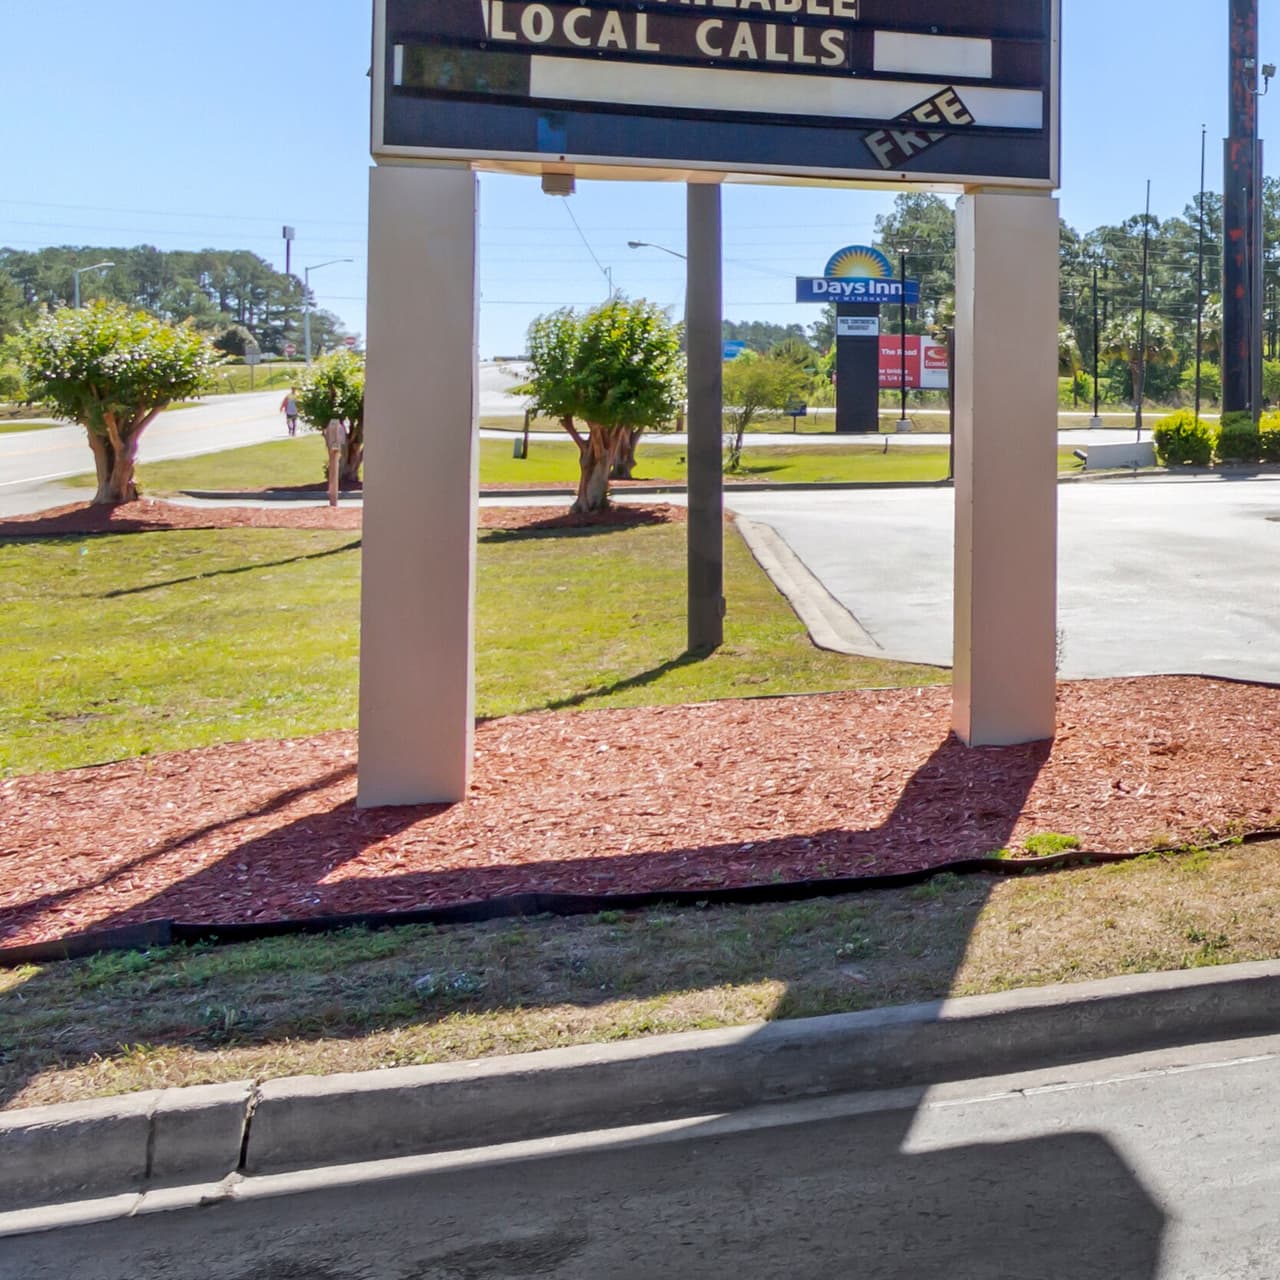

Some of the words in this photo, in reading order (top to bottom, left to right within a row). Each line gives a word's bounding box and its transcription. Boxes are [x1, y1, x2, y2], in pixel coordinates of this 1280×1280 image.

[491, 0, 660, 52] LOCAL
[695, 19, 845, 66] CALLS
[865, 90, 975, 169] FREE
[812, 279, 866, 295] Days
[869, 279, 903, 295] Inn
